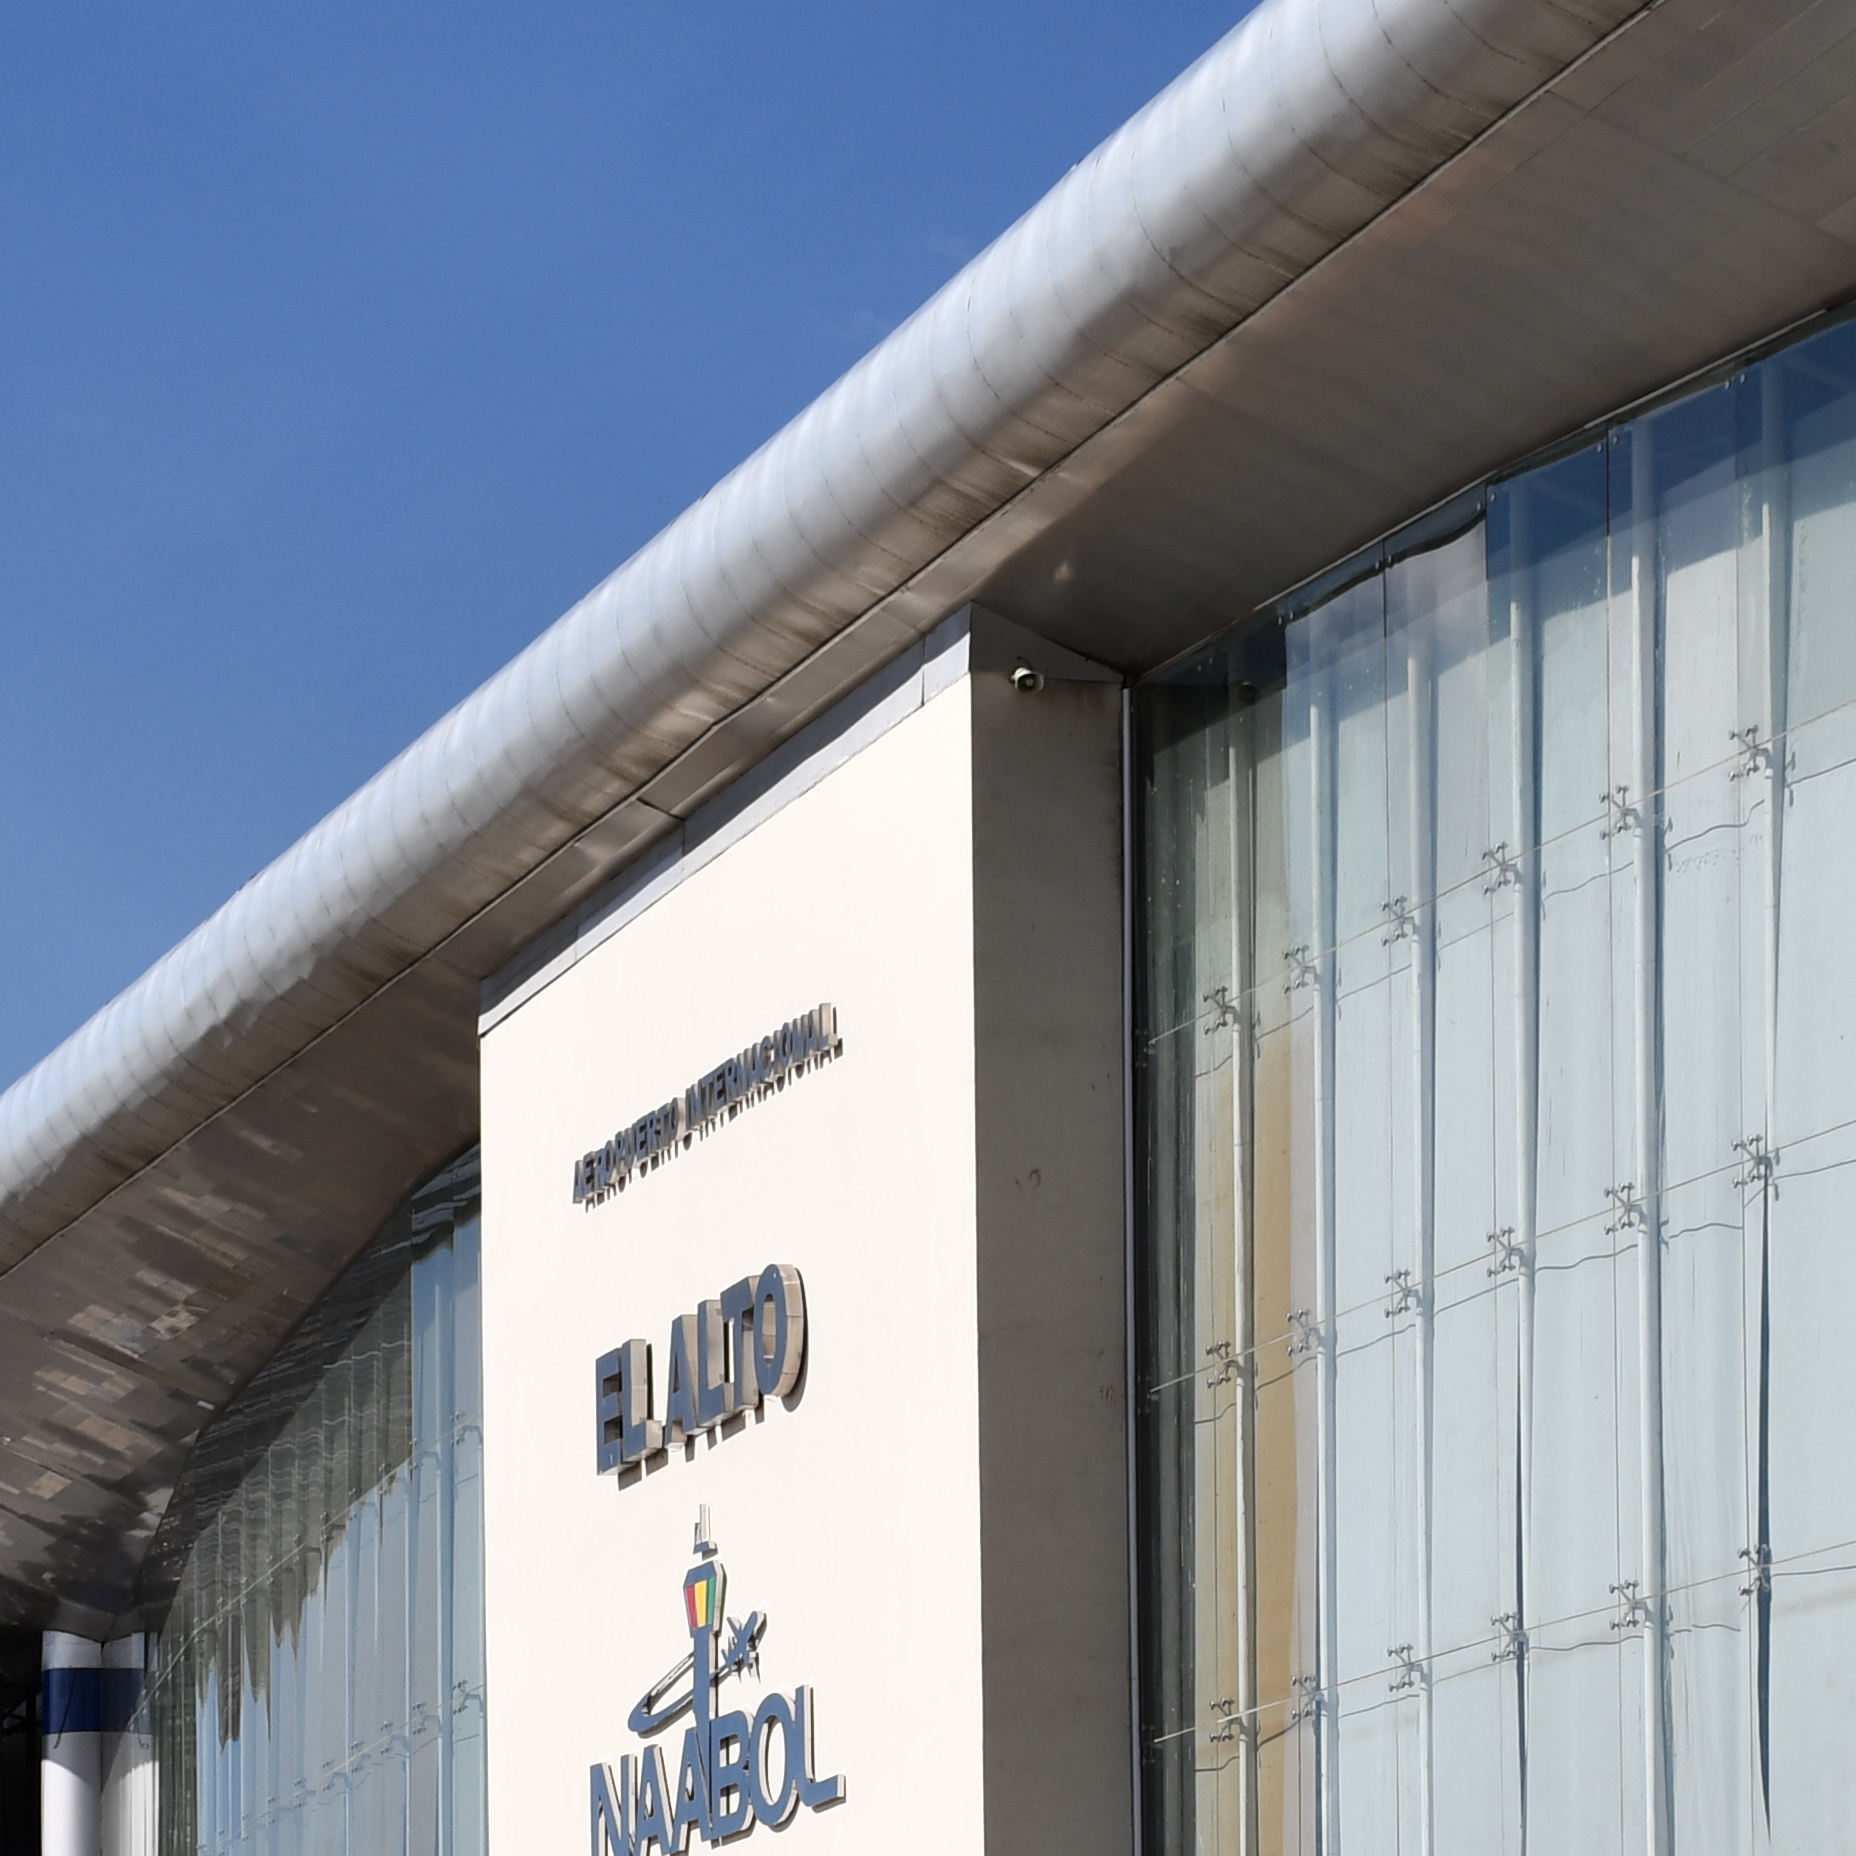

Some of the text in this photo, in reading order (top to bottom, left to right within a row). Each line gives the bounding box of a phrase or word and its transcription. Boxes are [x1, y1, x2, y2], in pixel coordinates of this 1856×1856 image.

[572, 1002, 839, 1204] AEROPUERTO INTERNACIONAL
[595, 1263, 805, 1476] EL ALTO
